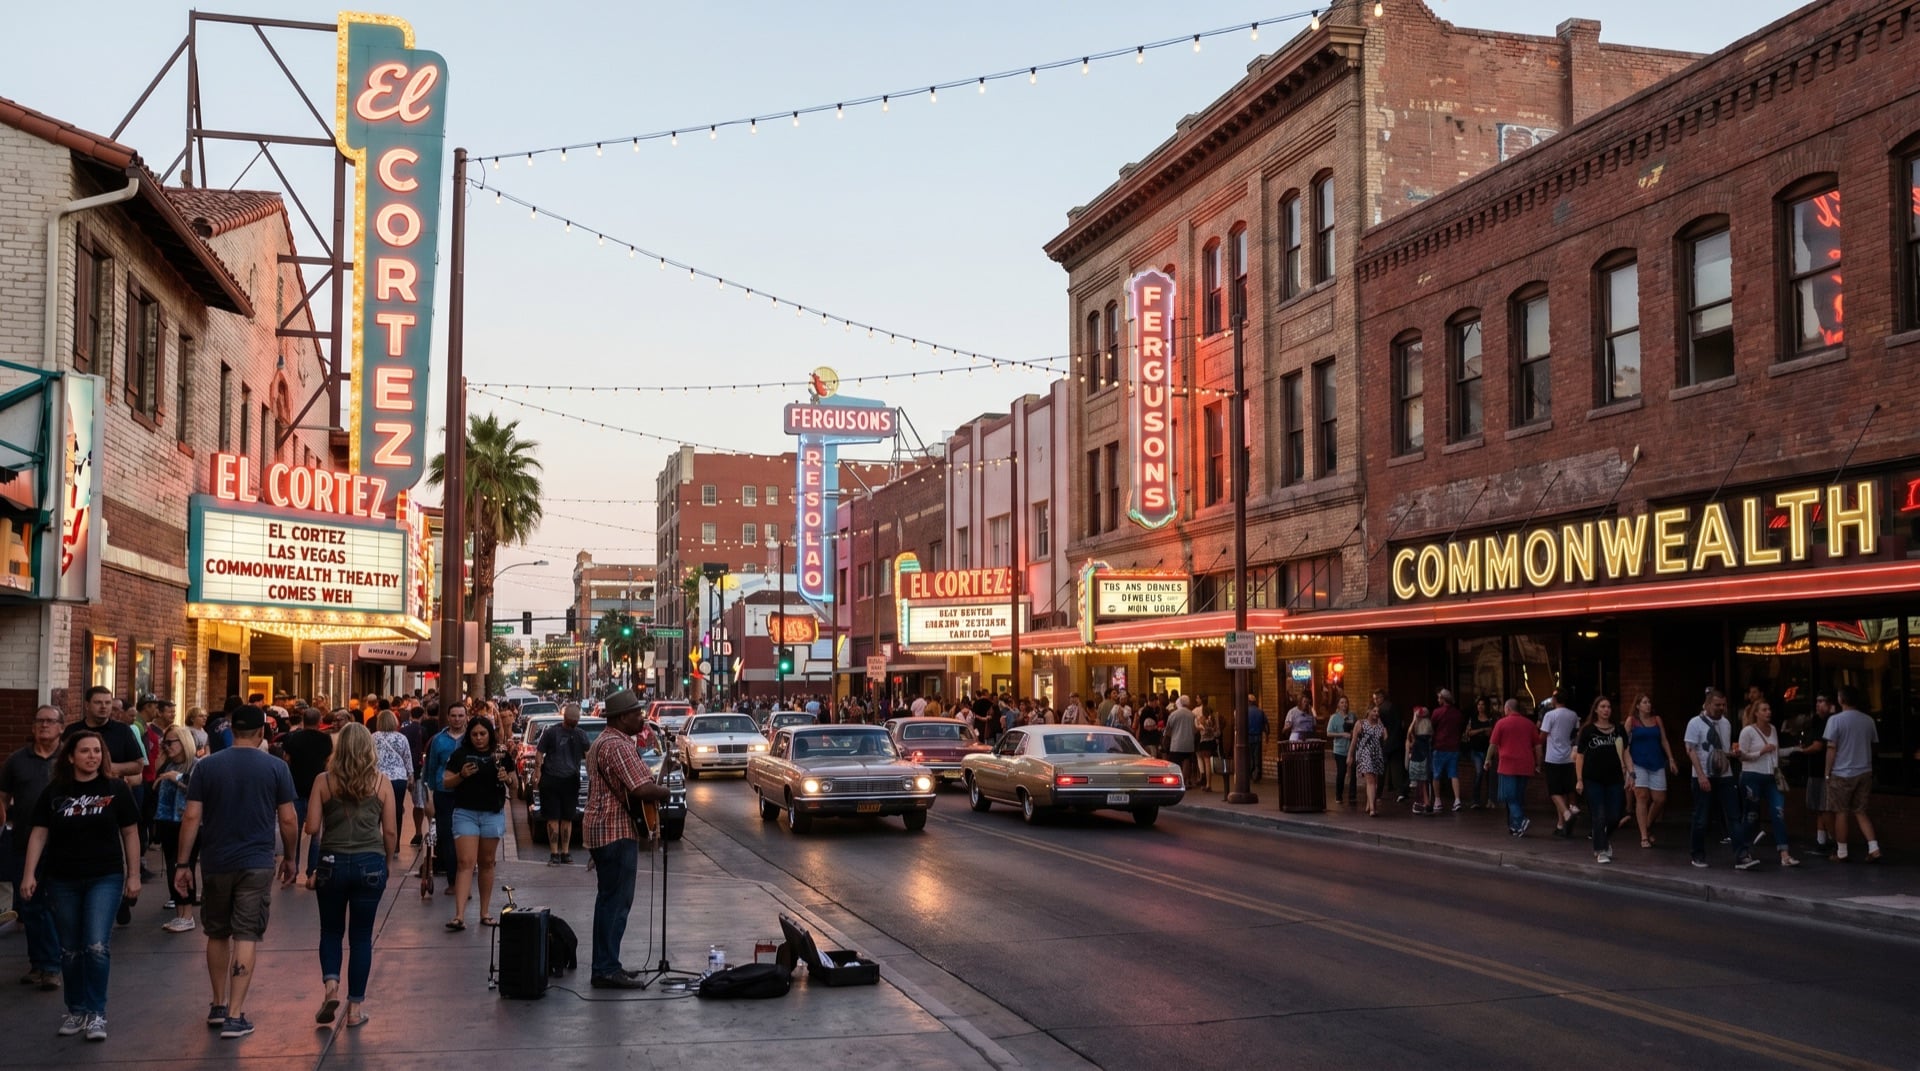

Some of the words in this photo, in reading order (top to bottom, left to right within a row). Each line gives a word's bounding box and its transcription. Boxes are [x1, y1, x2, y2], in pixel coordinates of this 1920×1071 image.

[356, 63, 439, 123] El
[374, 148, 421, 466] CORTEZ
[791, 408, 891, 431] FERGUSONS
[1143, 286, 1166, 508] FERGUSONS
[216, 453, 257, 503] EL
[270, 463, 387, 519] CORTEZ
[268, 523, 286, 540] EL
[291, 526, 346, 545] CORTEZ
[804, 450, 822, 587] RESOLAO
[1393, 481, 1876, 599] COMMONWEALTH
[205, 558, 332, 583] COMMONWEALTH
[338, 569, 399, 588] THEATRY
[268, 543, 295, 561] LAS
[301, 546, 346, 564] VEGAS
[268, 584, 316, 601] COMES
[322, 587, 353, 604] WEH
[911, 573, 931, 598] EL
